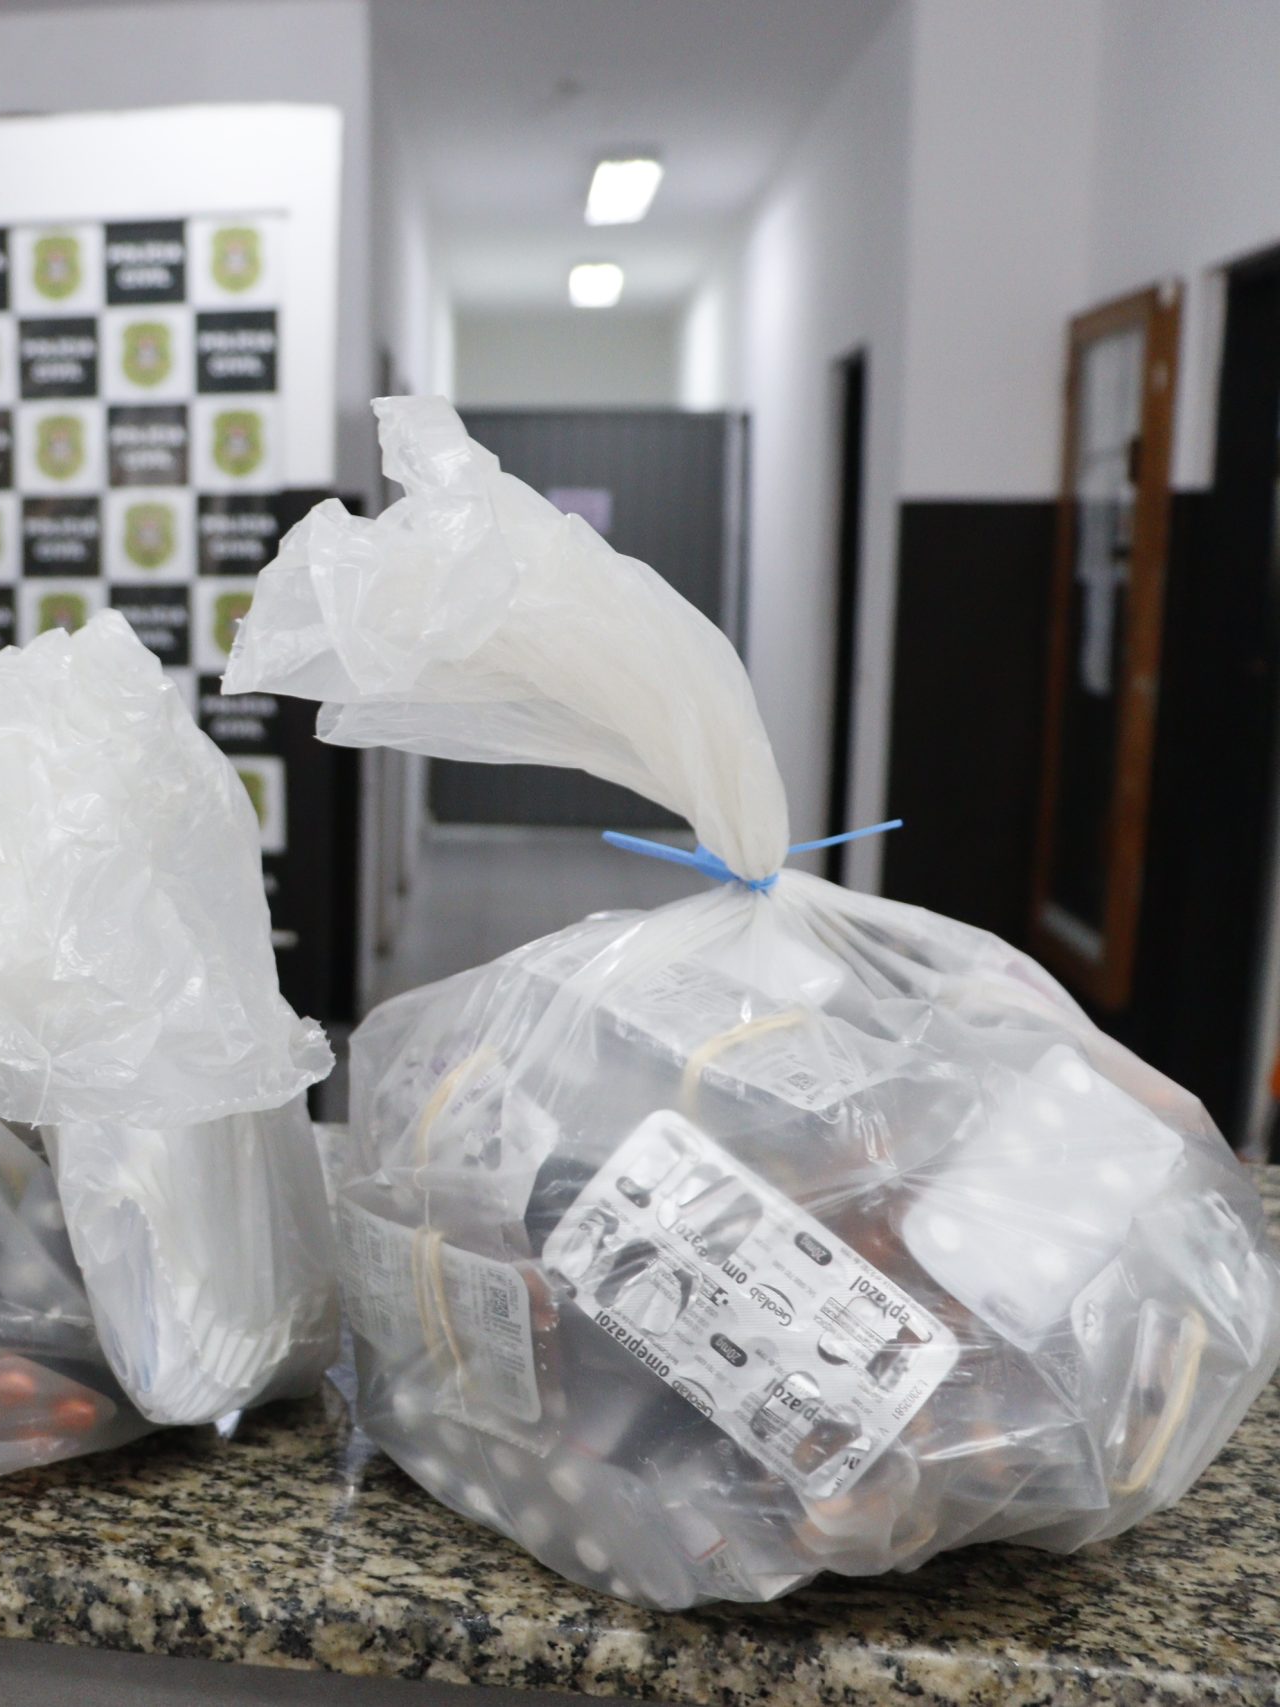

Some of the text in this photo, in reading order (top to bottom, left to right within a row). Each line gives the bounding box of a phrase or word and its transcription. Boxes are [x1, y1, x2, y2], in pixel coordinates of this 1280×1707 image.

[798, 1232, 828, 1263] 20mg
[745, 1284, 794, 1329] Geolab
[592, 1309, 671, 1379] omeprazol
[712, 1333, 743, 1365] 20mg
